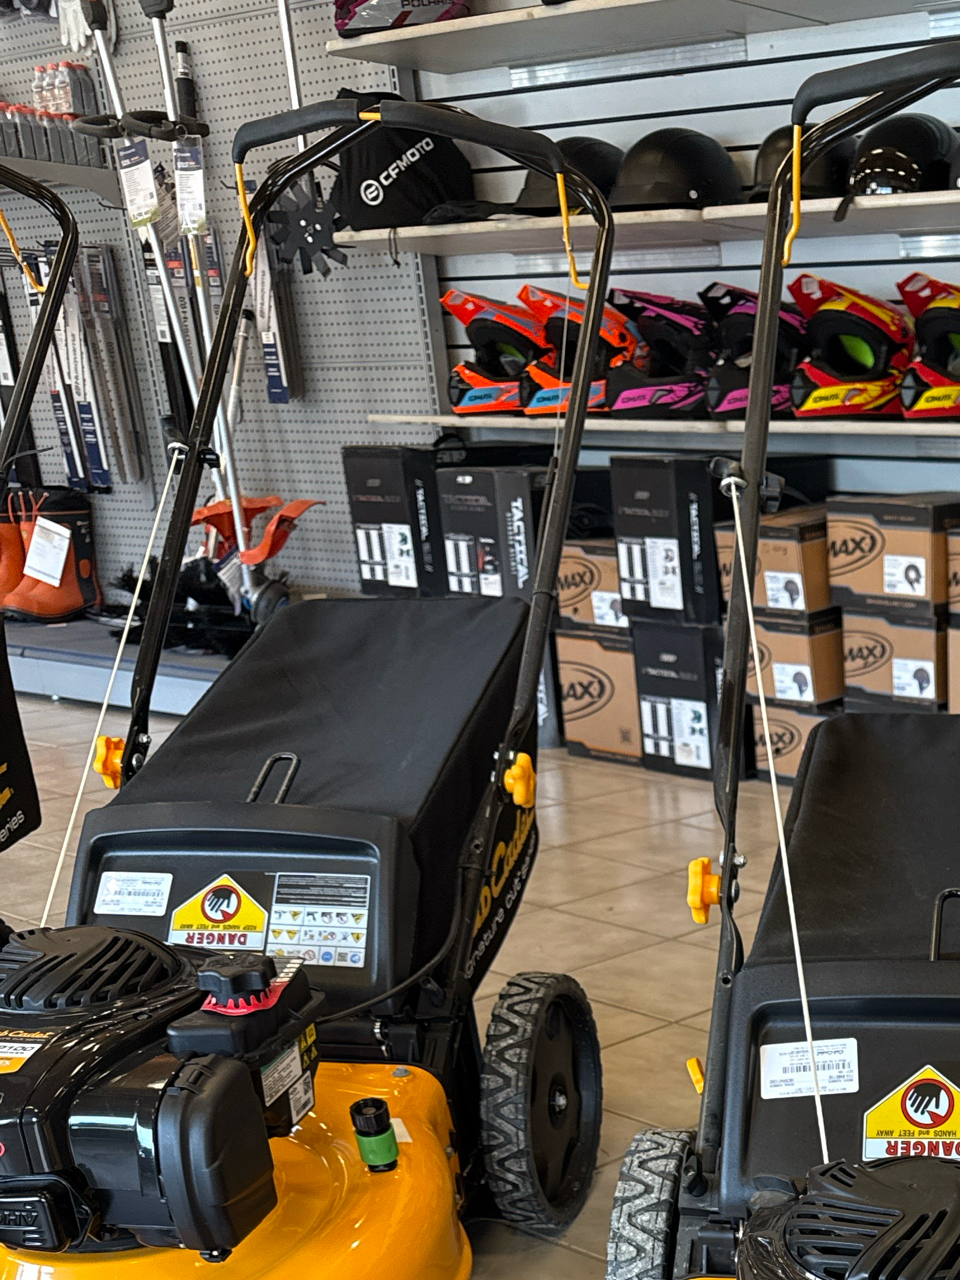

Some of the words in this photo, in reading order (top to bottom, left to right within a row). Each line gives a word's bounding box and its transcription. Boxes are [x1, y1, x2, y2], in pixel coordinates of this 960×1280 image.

[379, 137, 435, 186] CFMOTO
[511, 497, 529, 590] TACTICAL
[0, 809, 25, 844] eries
[185, 932, 248, 946] DANGER
